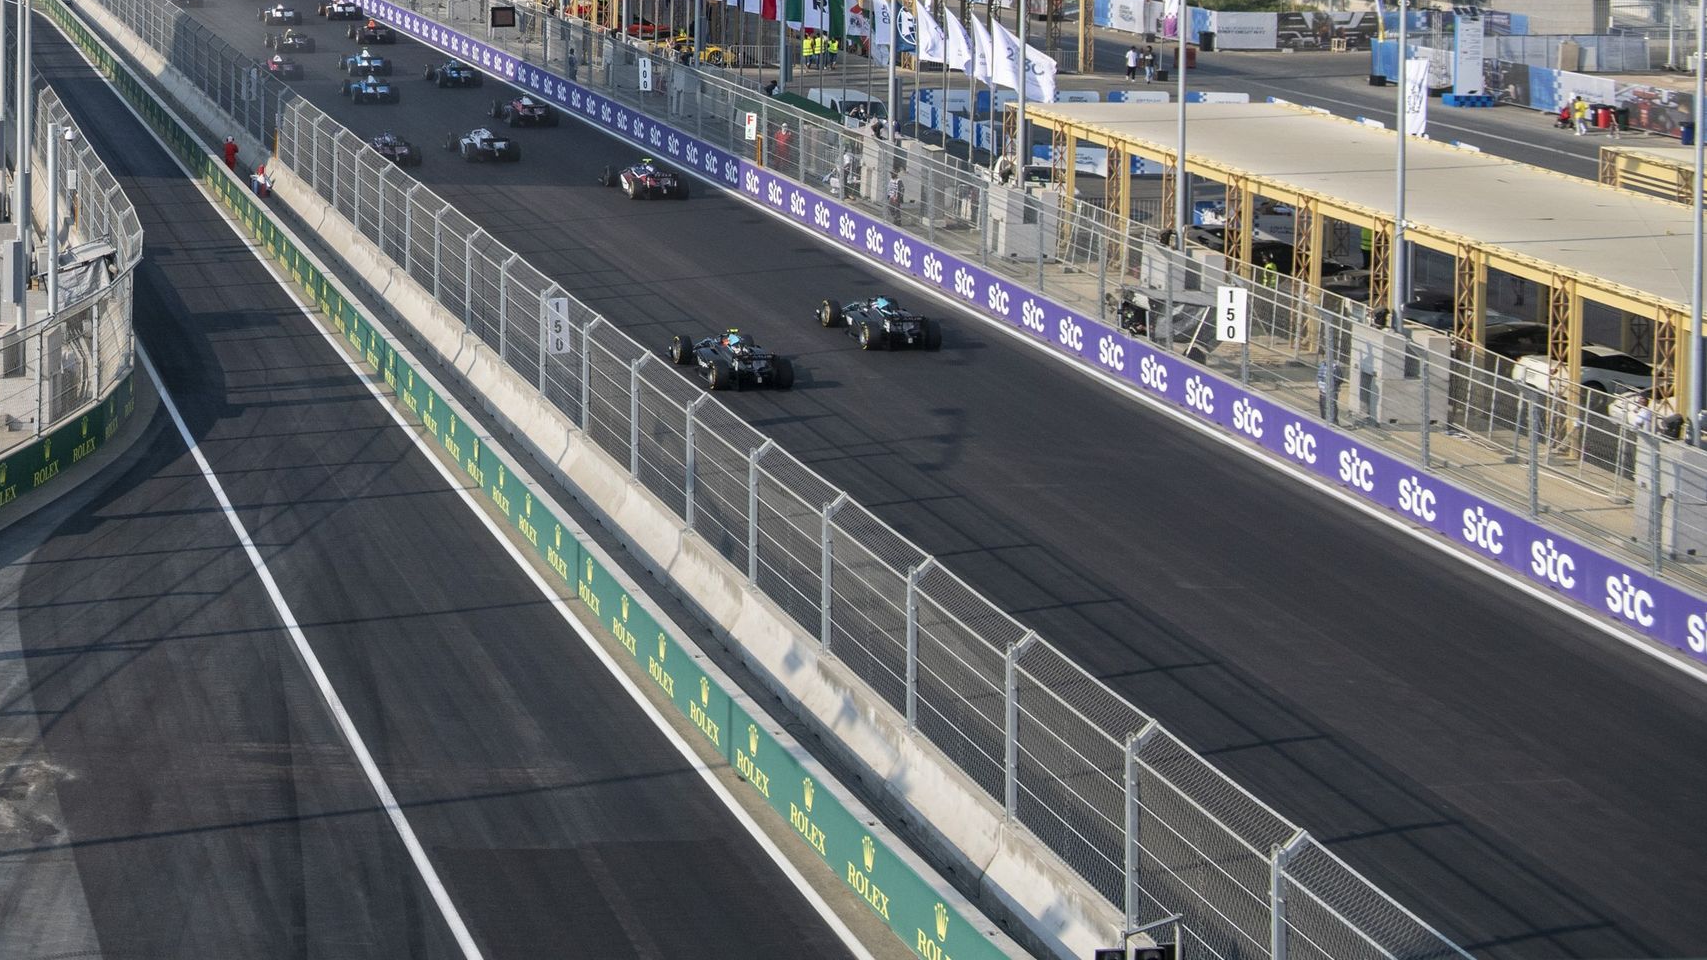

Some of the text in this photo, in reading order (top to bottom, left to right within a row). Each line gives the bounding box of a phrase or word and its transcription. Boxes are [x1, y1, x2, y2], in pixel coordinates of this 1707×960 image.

[634, 118, 644, 138] stc
[650, 125, 661, 146] stc
[748, 115, 754, 125] F
[668, 133, 679, 155] stc
[686, 142, 698, 164] stc
[706, 151, 717, 174] stc
[726, 160, 737, 183] stc
[746, 169, 759, 194] stc
[768, 180, 782, 205] stc
[791, 190, 805, 216] stc
[815, 202, 830, 228] stc
[840, 213, 855, 240] stc
[866, 226, 883, 254] stc
[894, 239, 911, 268] stc
[924, 253, 942, 283] stc
[955, 267, 974, 299] stc
[989, 283, 1009, 315] stc
[555, 302, 563, 351] 150
[1022, 299, 1044, 332] stc
[1226, 290, 1235, 339] 150
[1060, 316, 1083, 351] stc
[1099, 335, 1124, 370] stc
[1141, 355, 1167, 392] stc
[1186, 375, 1214, 414] stc
[424, 410, 437, 435] ROLEX
[1233, 398, 1263, 438] stc
[72, 437, 96, 462] ROLEX
[445, 435, 460, 461] ROLEX
[1284, 422, 1316, 464] stc
[33, 460, 60, 487] ROLEX
[468, 459, 484, 487] ROLEX
[1339, 448, 1373, 491] stc
[493, 486, 510, 516] ROLEX
[1399, 476, 1436, 521] stc
[519, 515, 537, 546] ROLEX
[1463, 506, 1503, 554] stc
[547, 546, 567, 580] ROLEX
[1531, 539, 1575, 588] stc
[579, 580, 600, 616] ROLEX
[1606, 574, 1654, 626] stc
[612, 617, 636, 656] ROLEX
[649, 656, 674, 698] ROLEX
[690, 700, 720, 746] ROLEX
[737, 748, 770, 798] ROLEX
[790, 802, 826, 856] ROLEX
[848, 861, 890, 920] ROLEX
[917, 928, 952, 960] ROL
